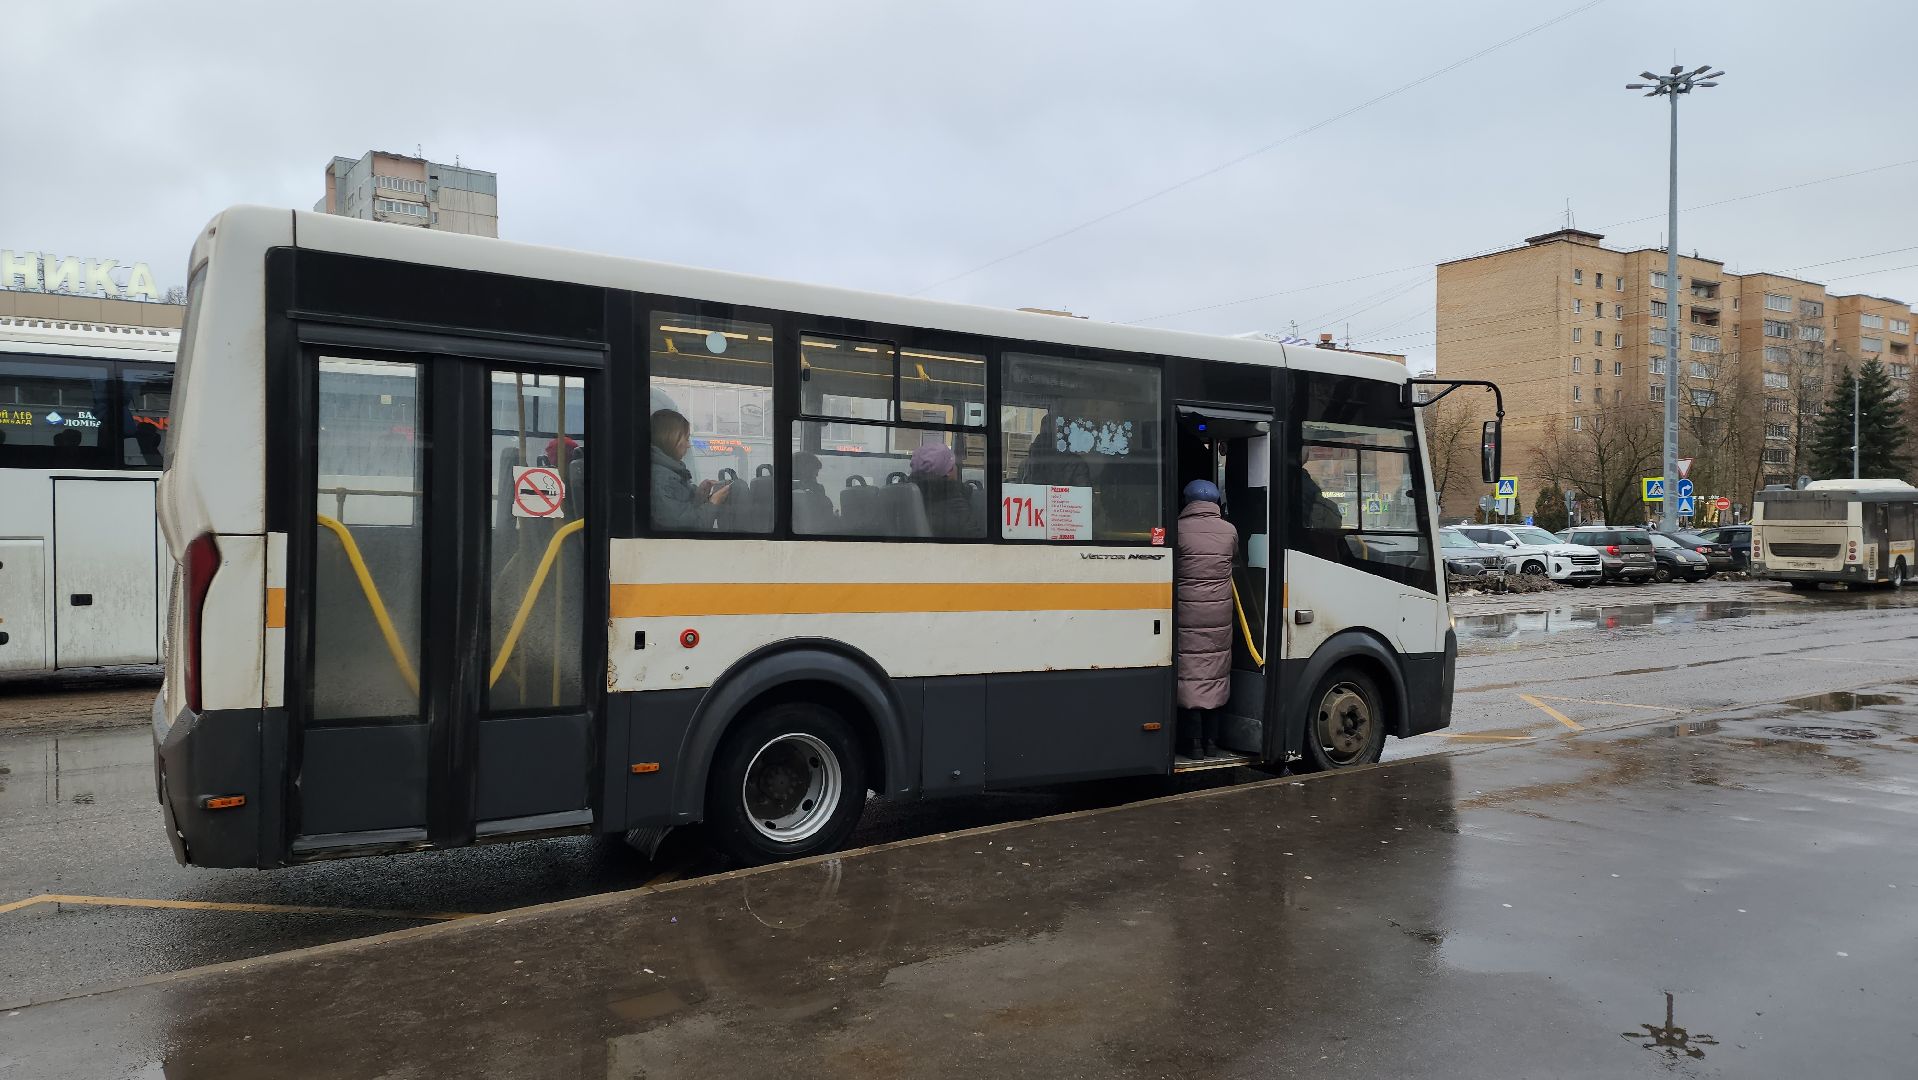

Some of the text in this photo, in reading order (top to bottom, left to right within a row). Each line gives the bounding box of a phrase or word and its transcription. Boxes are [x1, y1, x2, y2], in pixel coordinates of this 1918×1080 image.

[2, 250, 159, 299] НИКА
[13, 411, 32, 420] ЛЕВ
[78, 411, 97, 420] ВА
